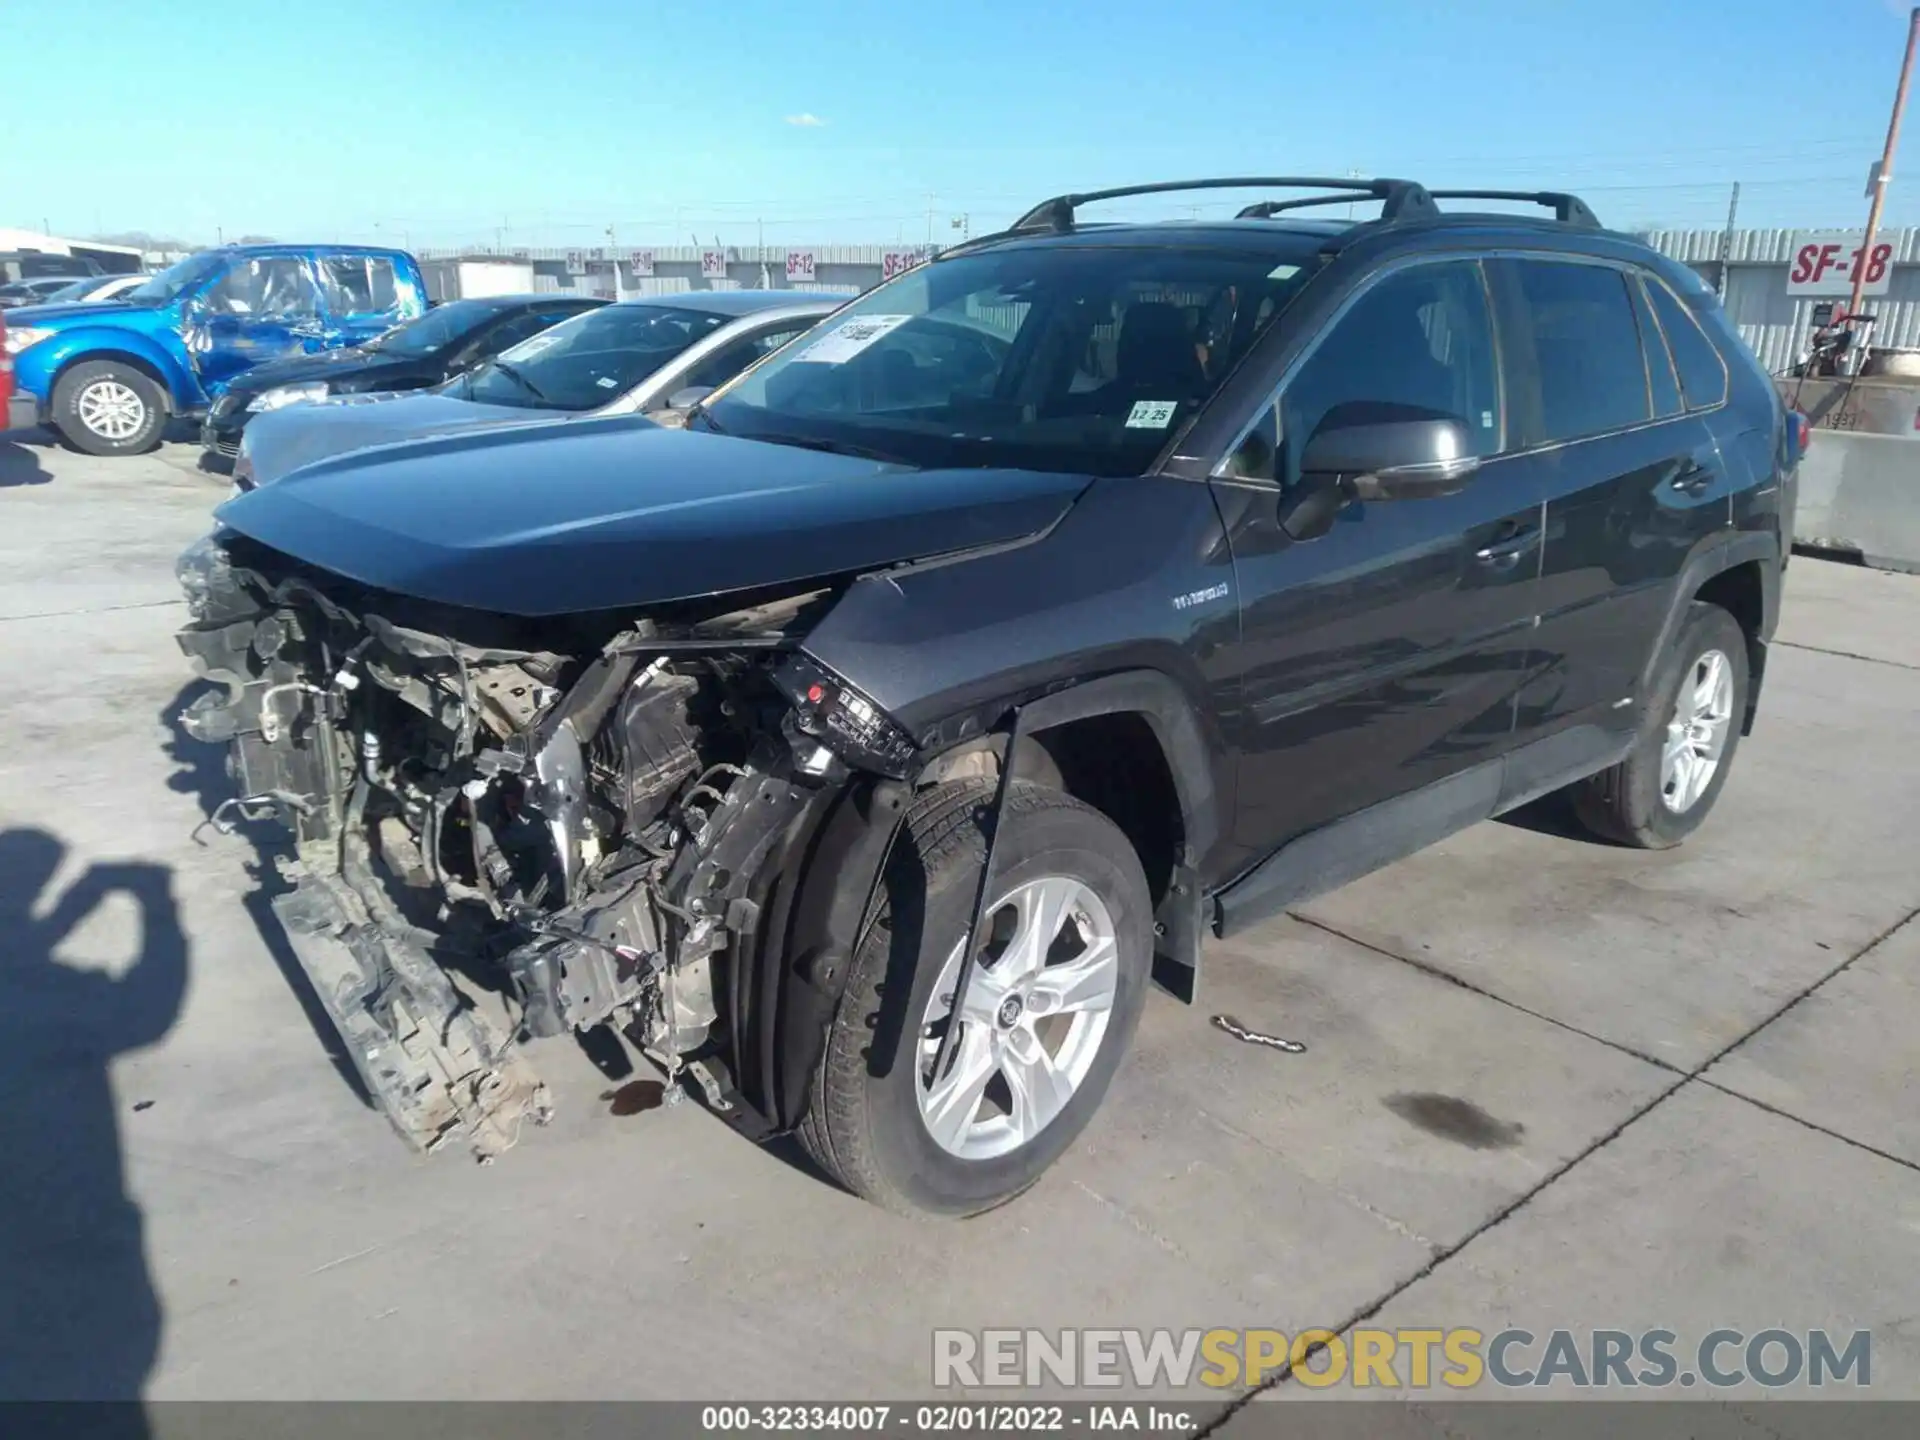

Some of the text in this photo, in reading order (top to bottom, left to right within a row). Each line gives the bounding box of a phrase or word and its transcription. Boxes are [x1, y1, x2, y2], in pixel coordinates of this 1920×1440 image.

[703, 252, 724, 272] SF-11
[787, 253, 813, 274] SF-12
[1791, 244, 1893, 284] SF-18
